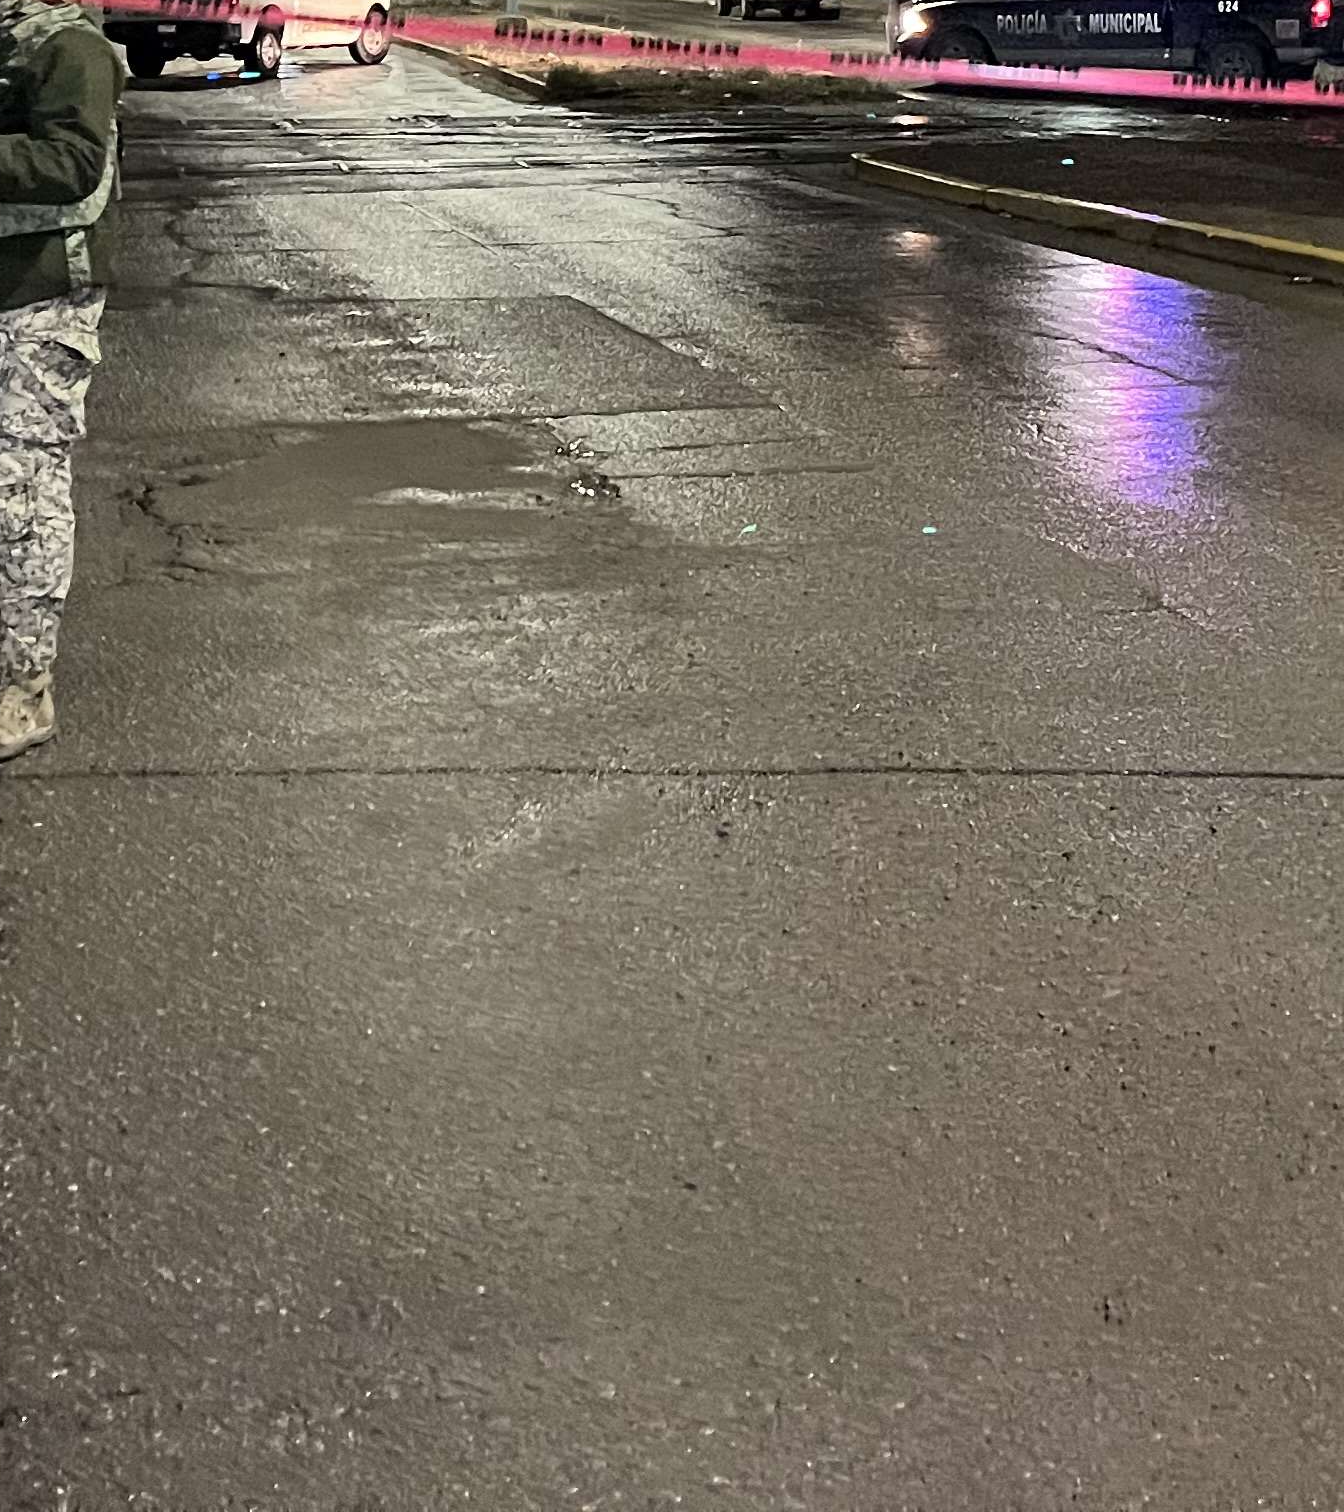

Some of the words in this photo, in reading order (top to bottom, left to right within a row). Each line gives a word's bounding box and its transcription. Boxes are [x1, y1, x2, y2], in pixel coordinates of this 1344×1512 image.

[1217, 0, 1239, 13] 624
[996, 9, 1048, 34] POLICÍA
[1088, 12, 1162, 34] MUNICIPAL
